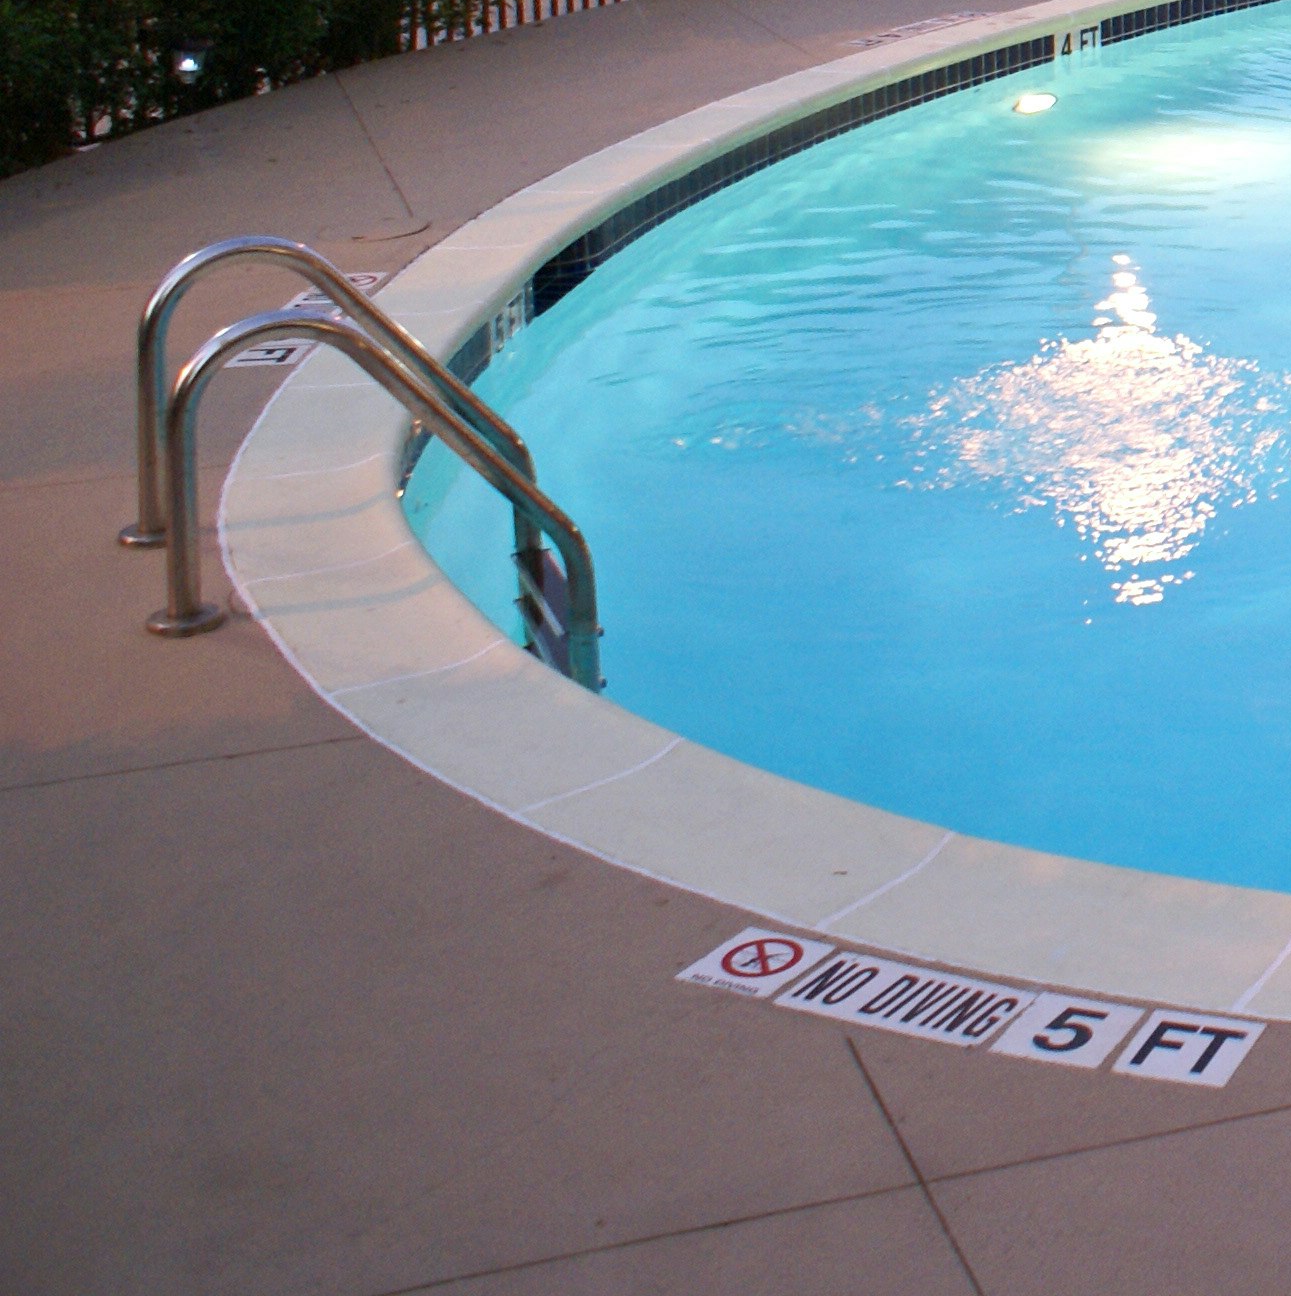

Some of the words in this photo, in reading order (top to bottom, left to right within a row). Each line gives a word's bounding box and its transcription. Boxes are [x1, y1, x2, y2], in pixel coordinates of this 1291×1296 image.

[1061, 33, 1072, 56] 4
[1080, 25, 1098, 51] FT
[794, 959, 869, 1004] NO
[860, 974, 1018, 1036] DIVING
[1032, 1008, 1108, 1052] 5
[1130, 1020, 1247, 1075] FT
